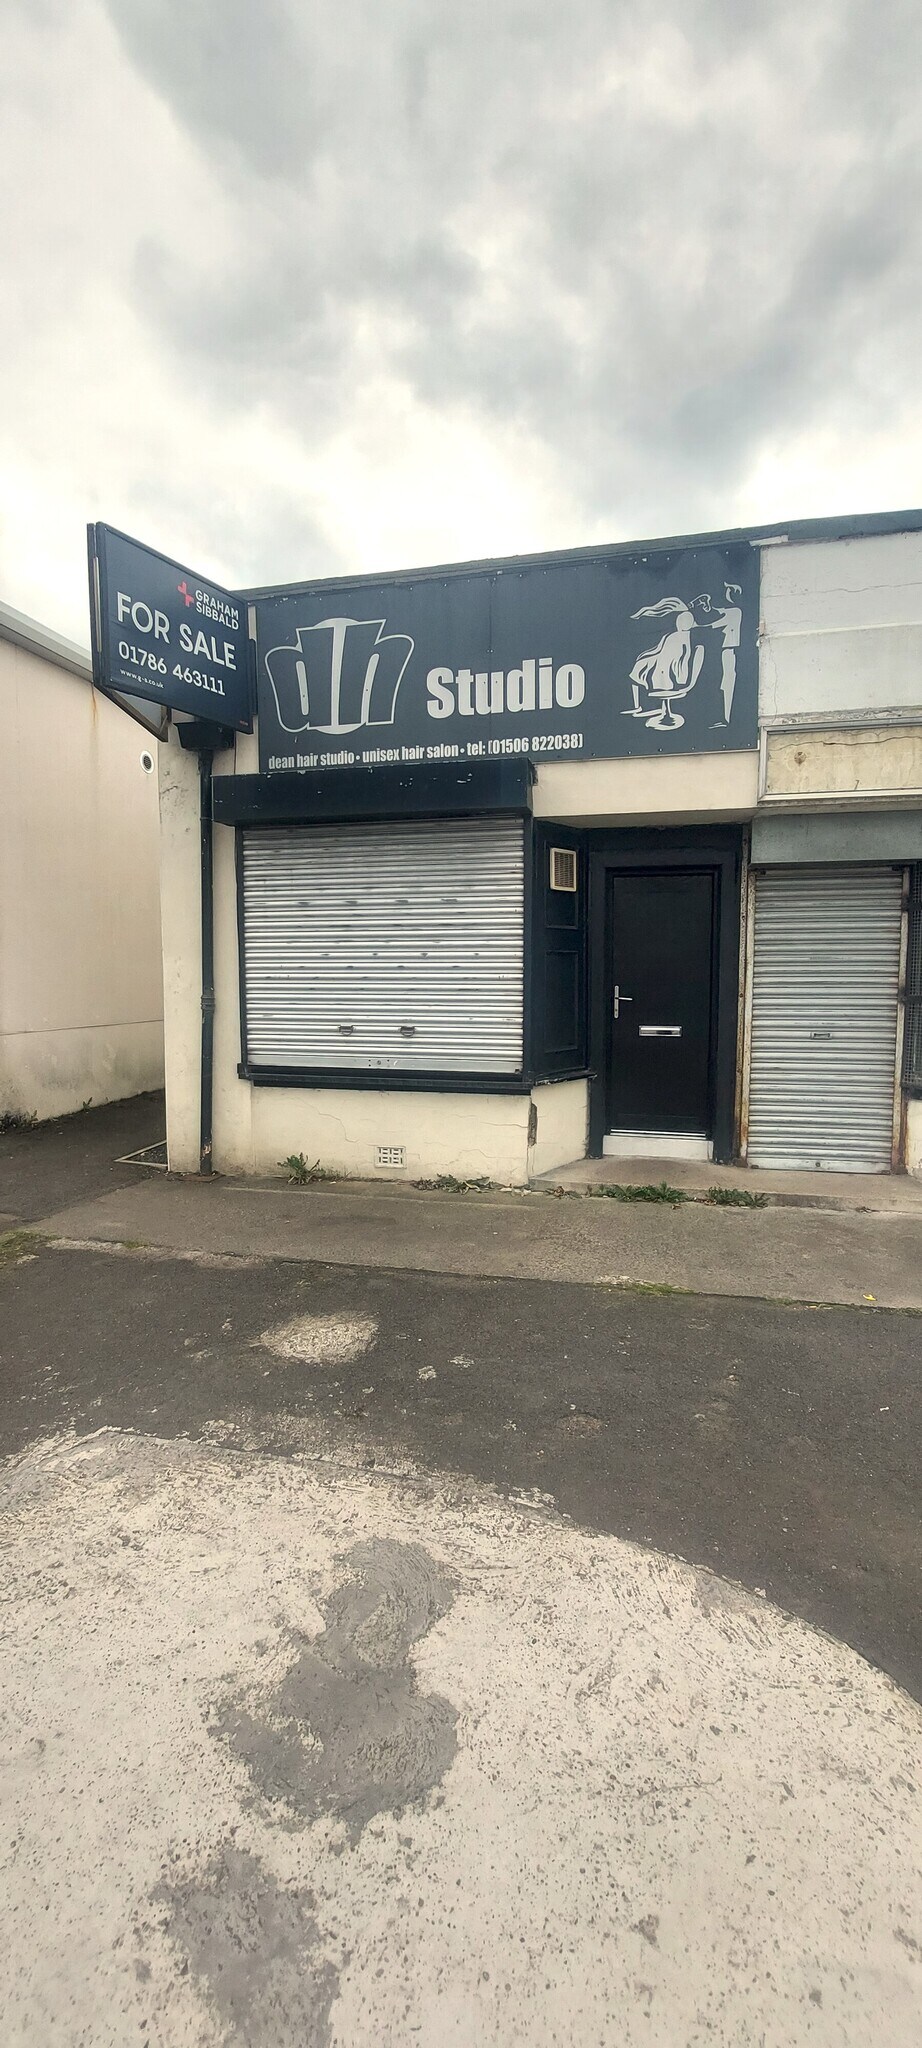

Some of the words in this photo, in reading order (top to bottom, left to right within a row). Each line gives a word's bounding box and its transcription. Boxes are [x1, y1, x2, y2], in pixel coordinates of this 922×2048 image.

[195, 590, 239, 620] GRAHAM
[196, 602, 239, 630] SIBBALD
[117, 591, 170, 644] FOR
[179, 623, 237, 670] SALE
[118, 641, 167, 674] 01786
[173, 664, 226, 696] 463111
[426, 657, 585, 719] Studio
[268, 755, 295, 770] dean
[296, 752, 319, 768] hair
[362, 746, 400, 763] unisex
[401, 744, 425, 760] hair
[467, 740, 486, 756] tel:
